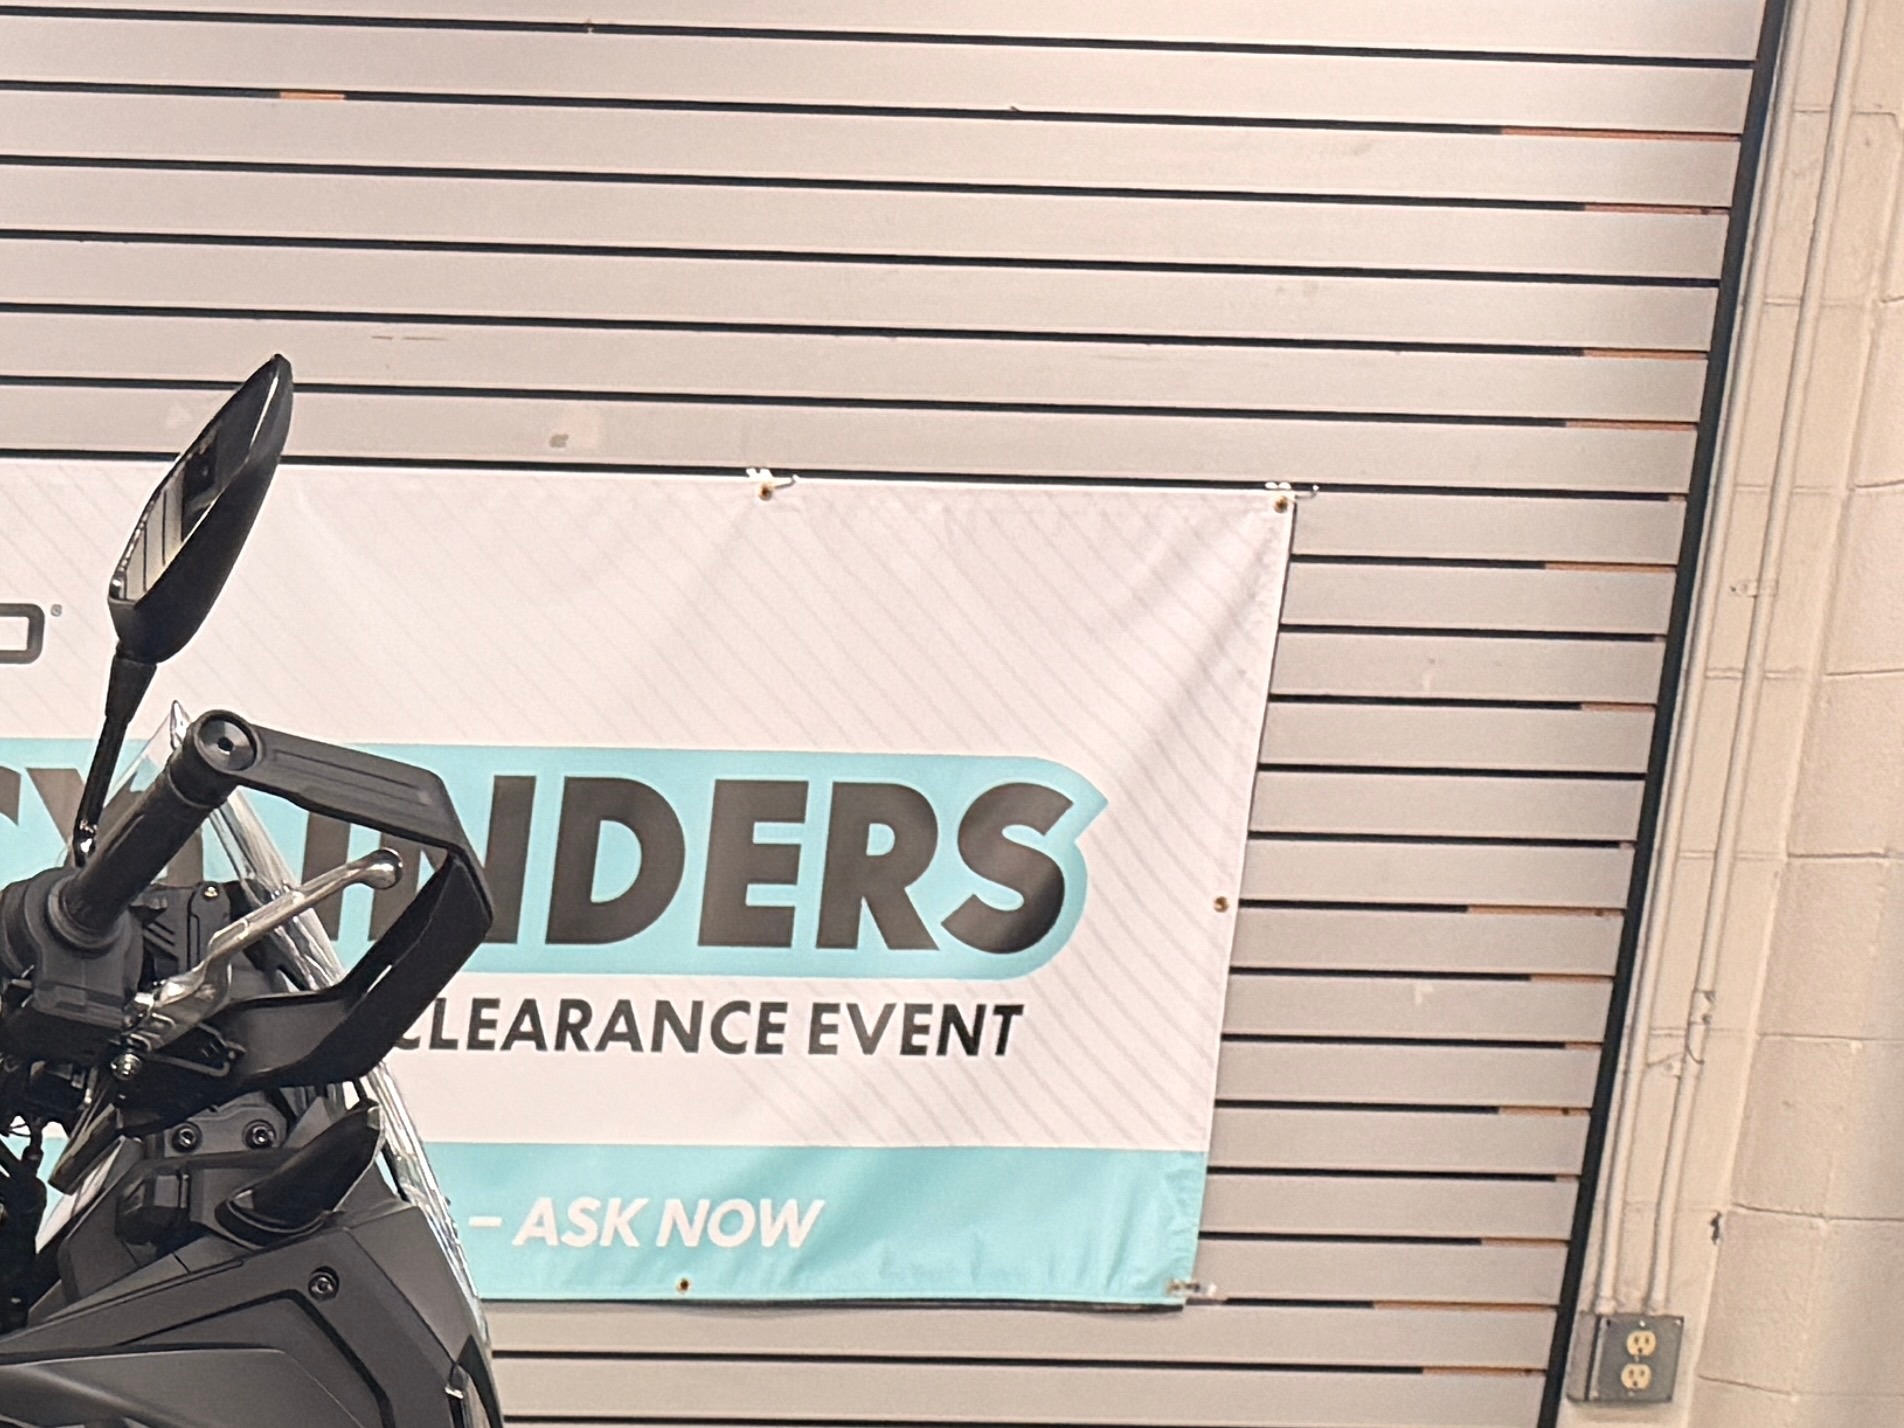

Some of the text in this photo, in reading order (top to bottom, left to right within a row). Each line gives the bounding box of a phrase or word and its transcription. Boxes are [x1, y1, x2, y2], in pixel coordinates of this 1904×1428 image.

[808, 1002, 1025, 1057] EVENT
[511, 1196, 649, 1248] ASK
[655, 1197, 826, 1249] NOW
